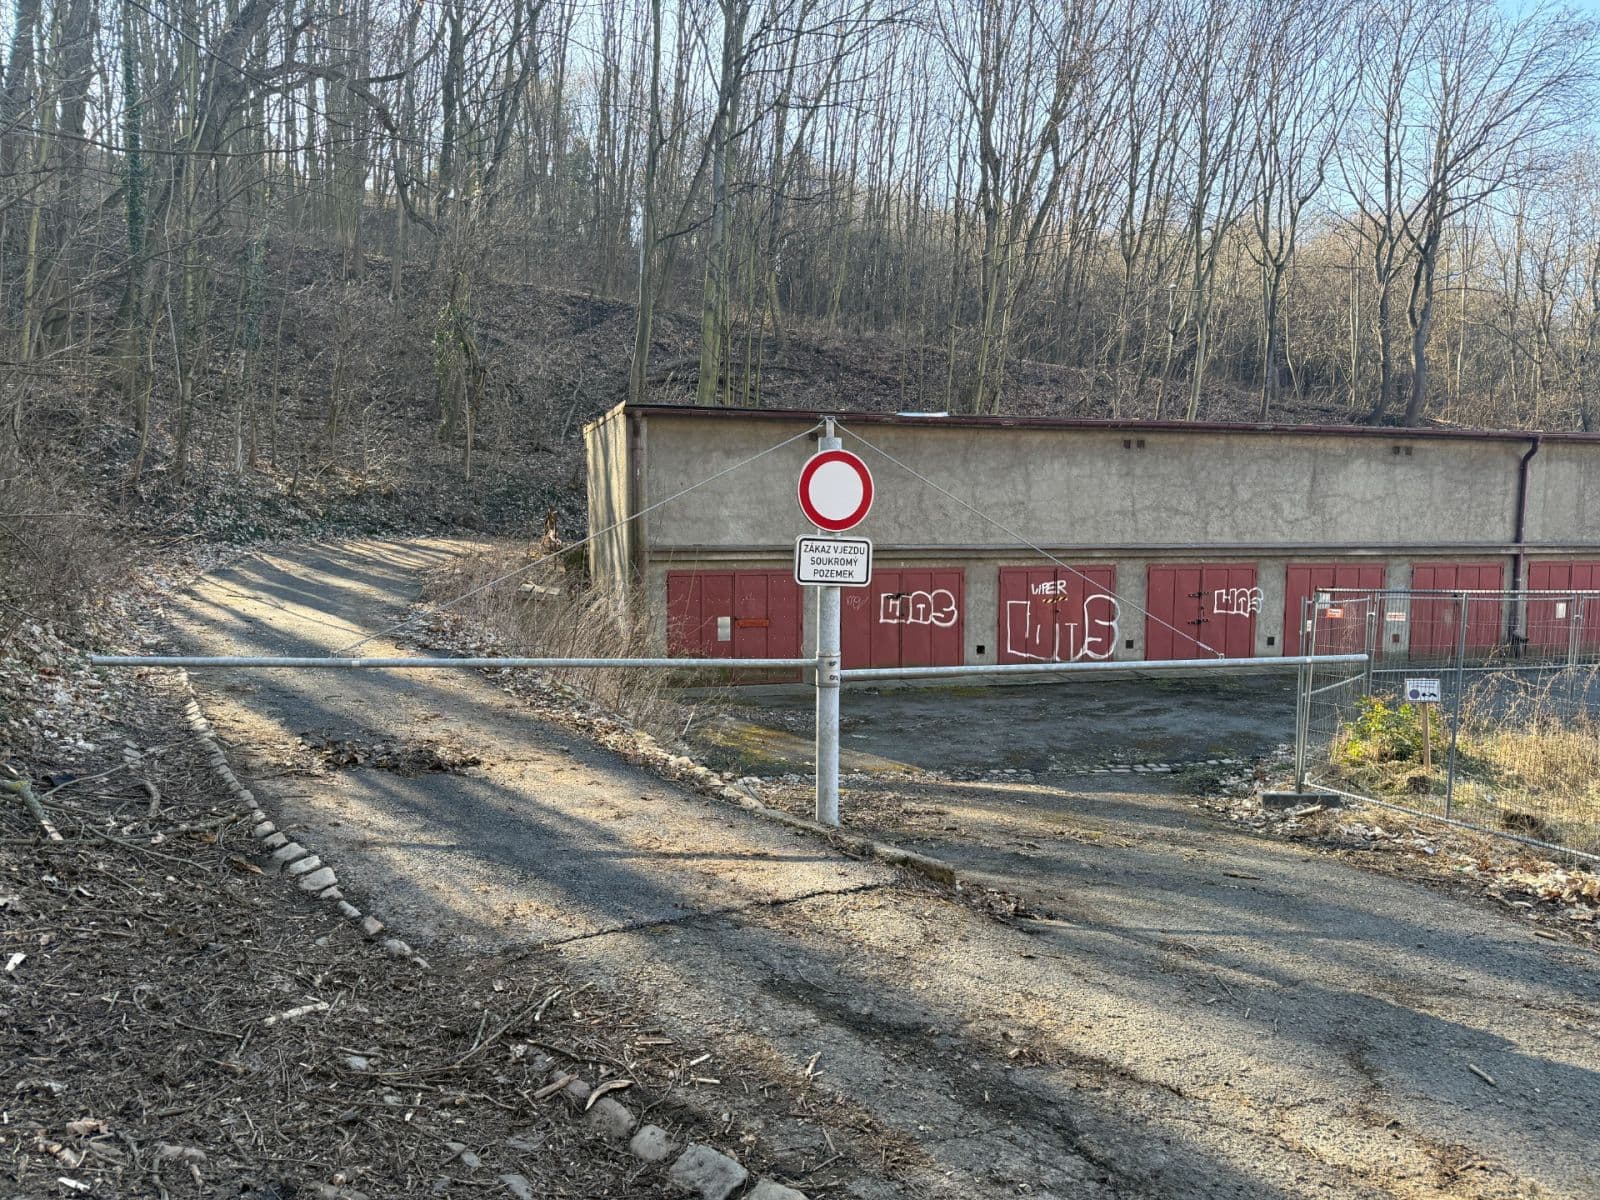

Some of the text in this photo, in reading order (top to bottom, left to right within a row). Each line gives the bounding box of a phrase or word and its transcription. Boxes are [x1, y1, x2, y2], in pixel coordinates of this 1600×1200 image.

[803, 542, 865, 555] ZÁKAZ VJEZDU
[810, 556, 859, 566] SOUKROMÝ
[813, 568, 854, 578] POZEMEK
